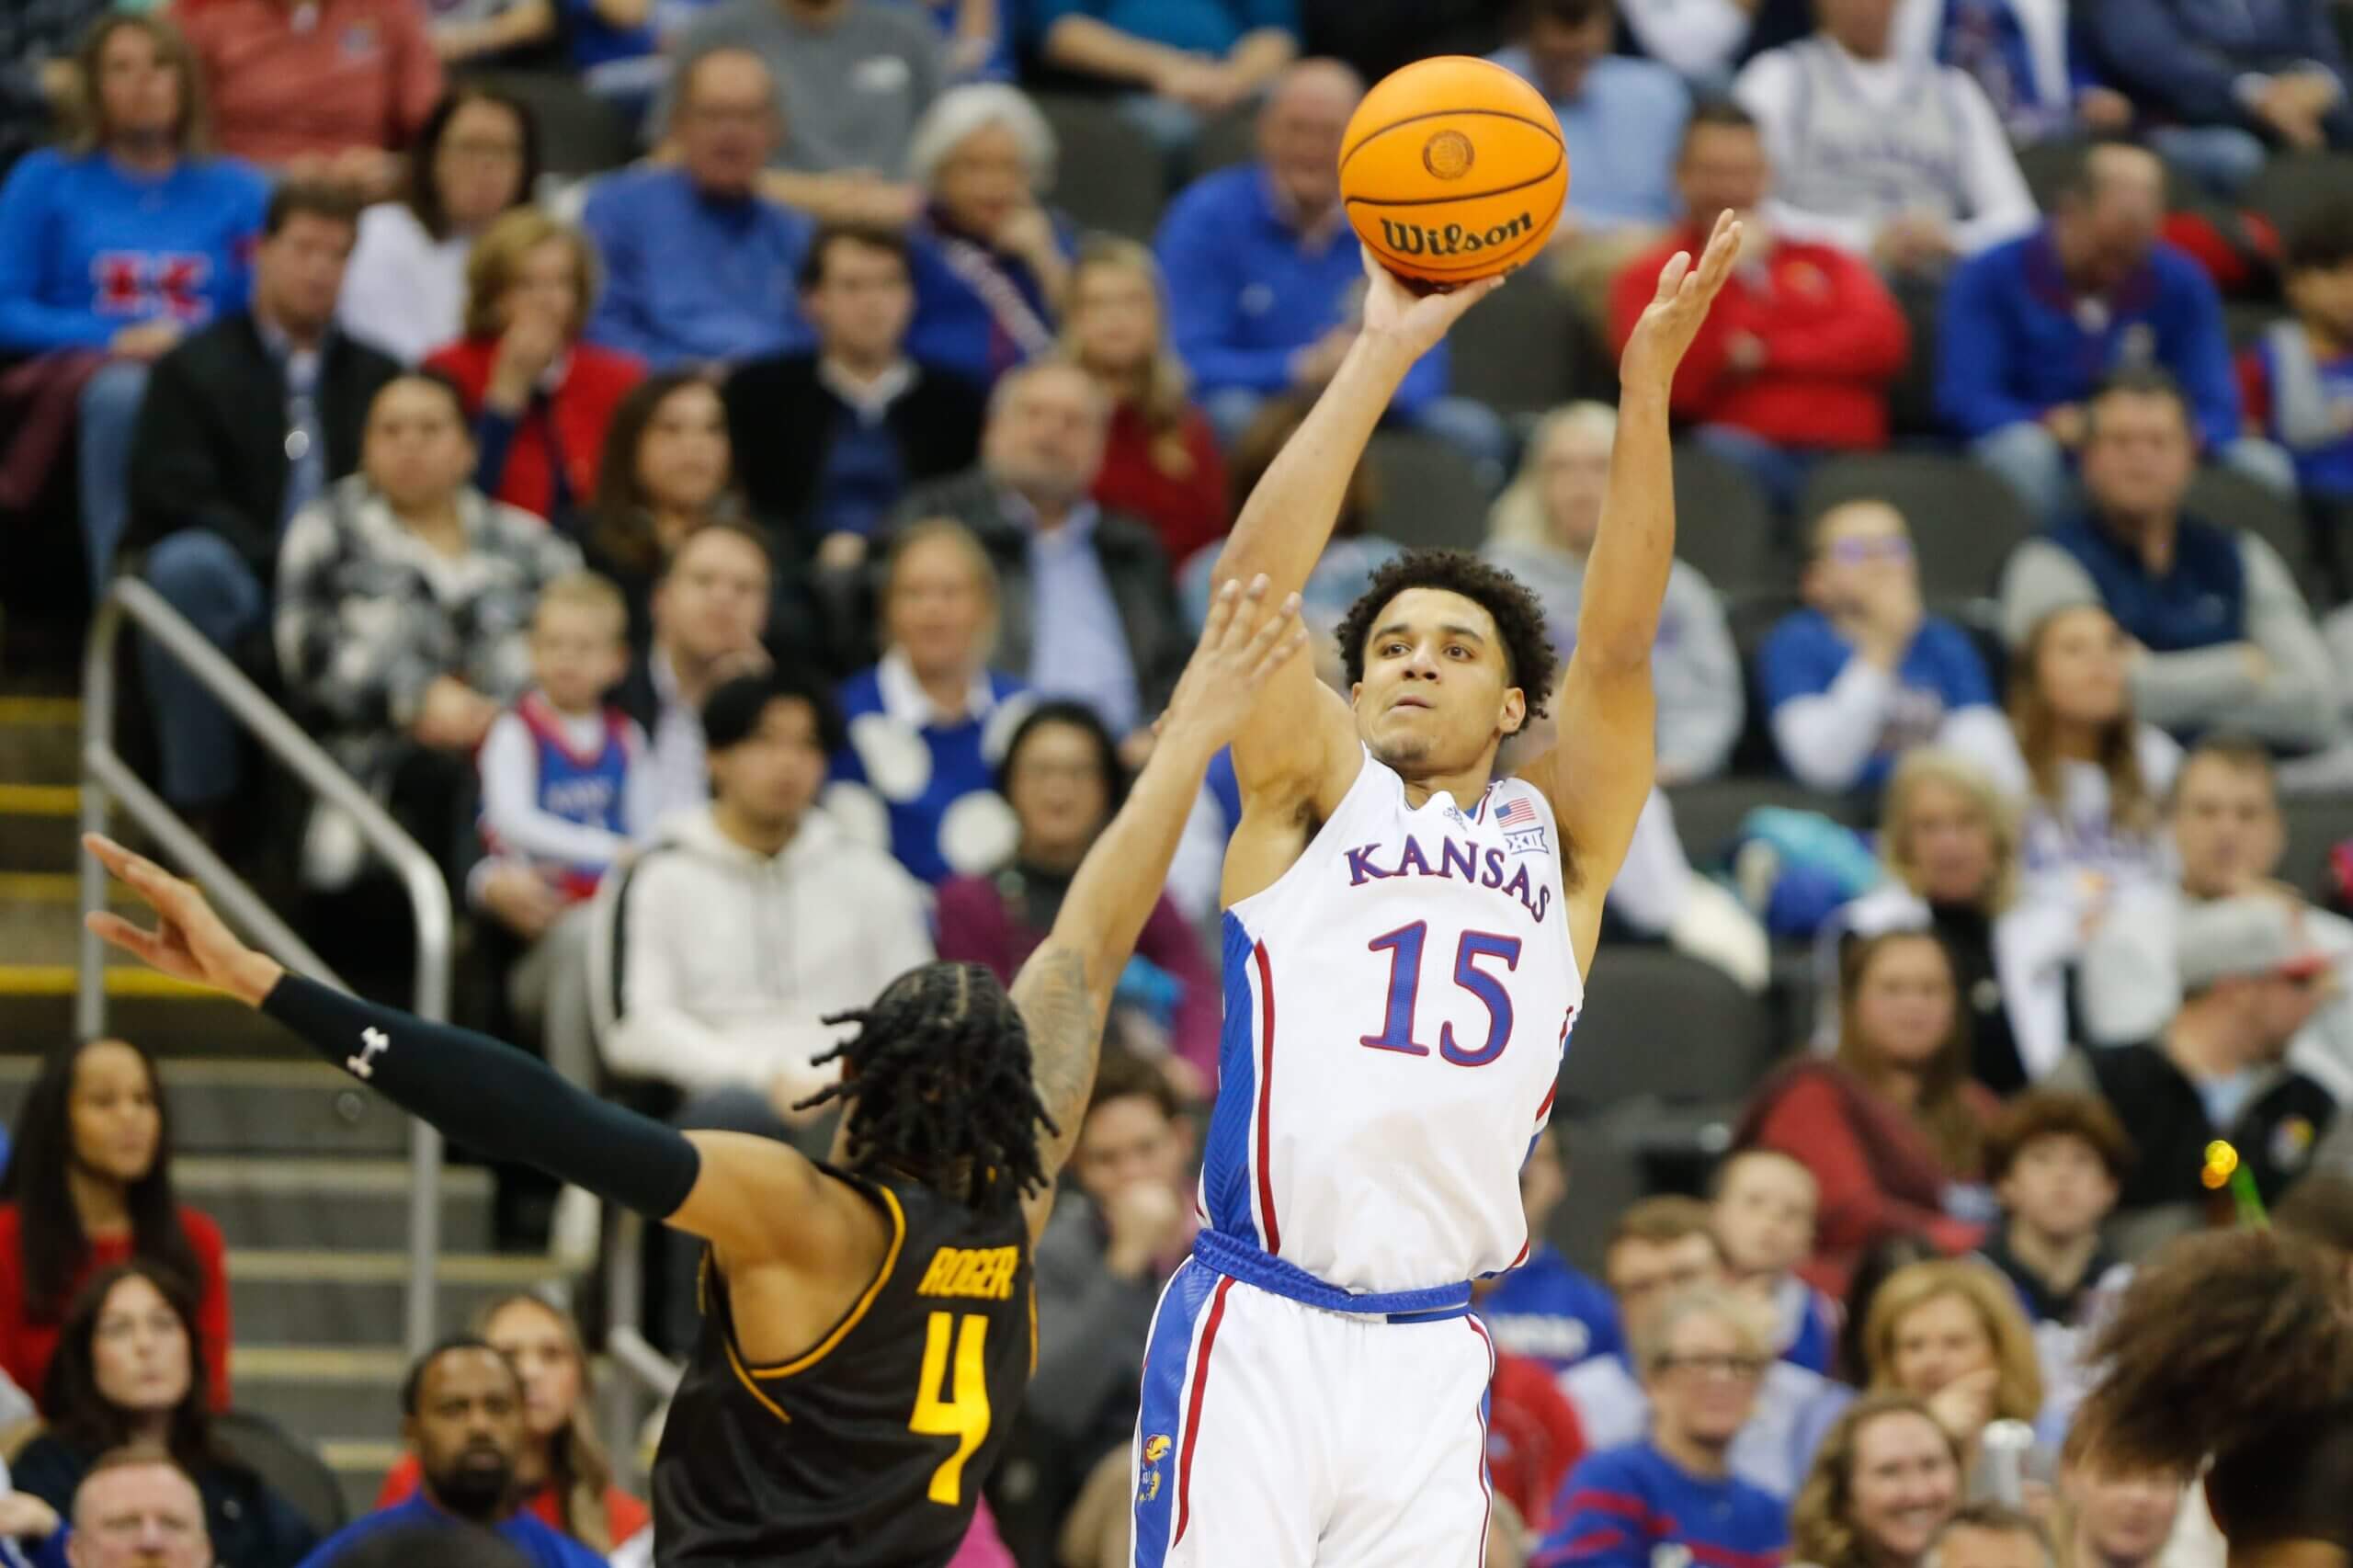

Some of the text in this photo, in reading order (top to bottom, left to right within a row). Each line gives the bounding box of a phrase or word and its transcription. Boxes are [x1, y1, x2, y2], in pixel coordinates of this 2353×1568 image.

[1380, 211, 1533, 256] Wilson
[1344, 834, 1551, 923] KANSAS
[1359, 919, 1522, 1067] 15
[908, 1310, 992, 1507] 4
